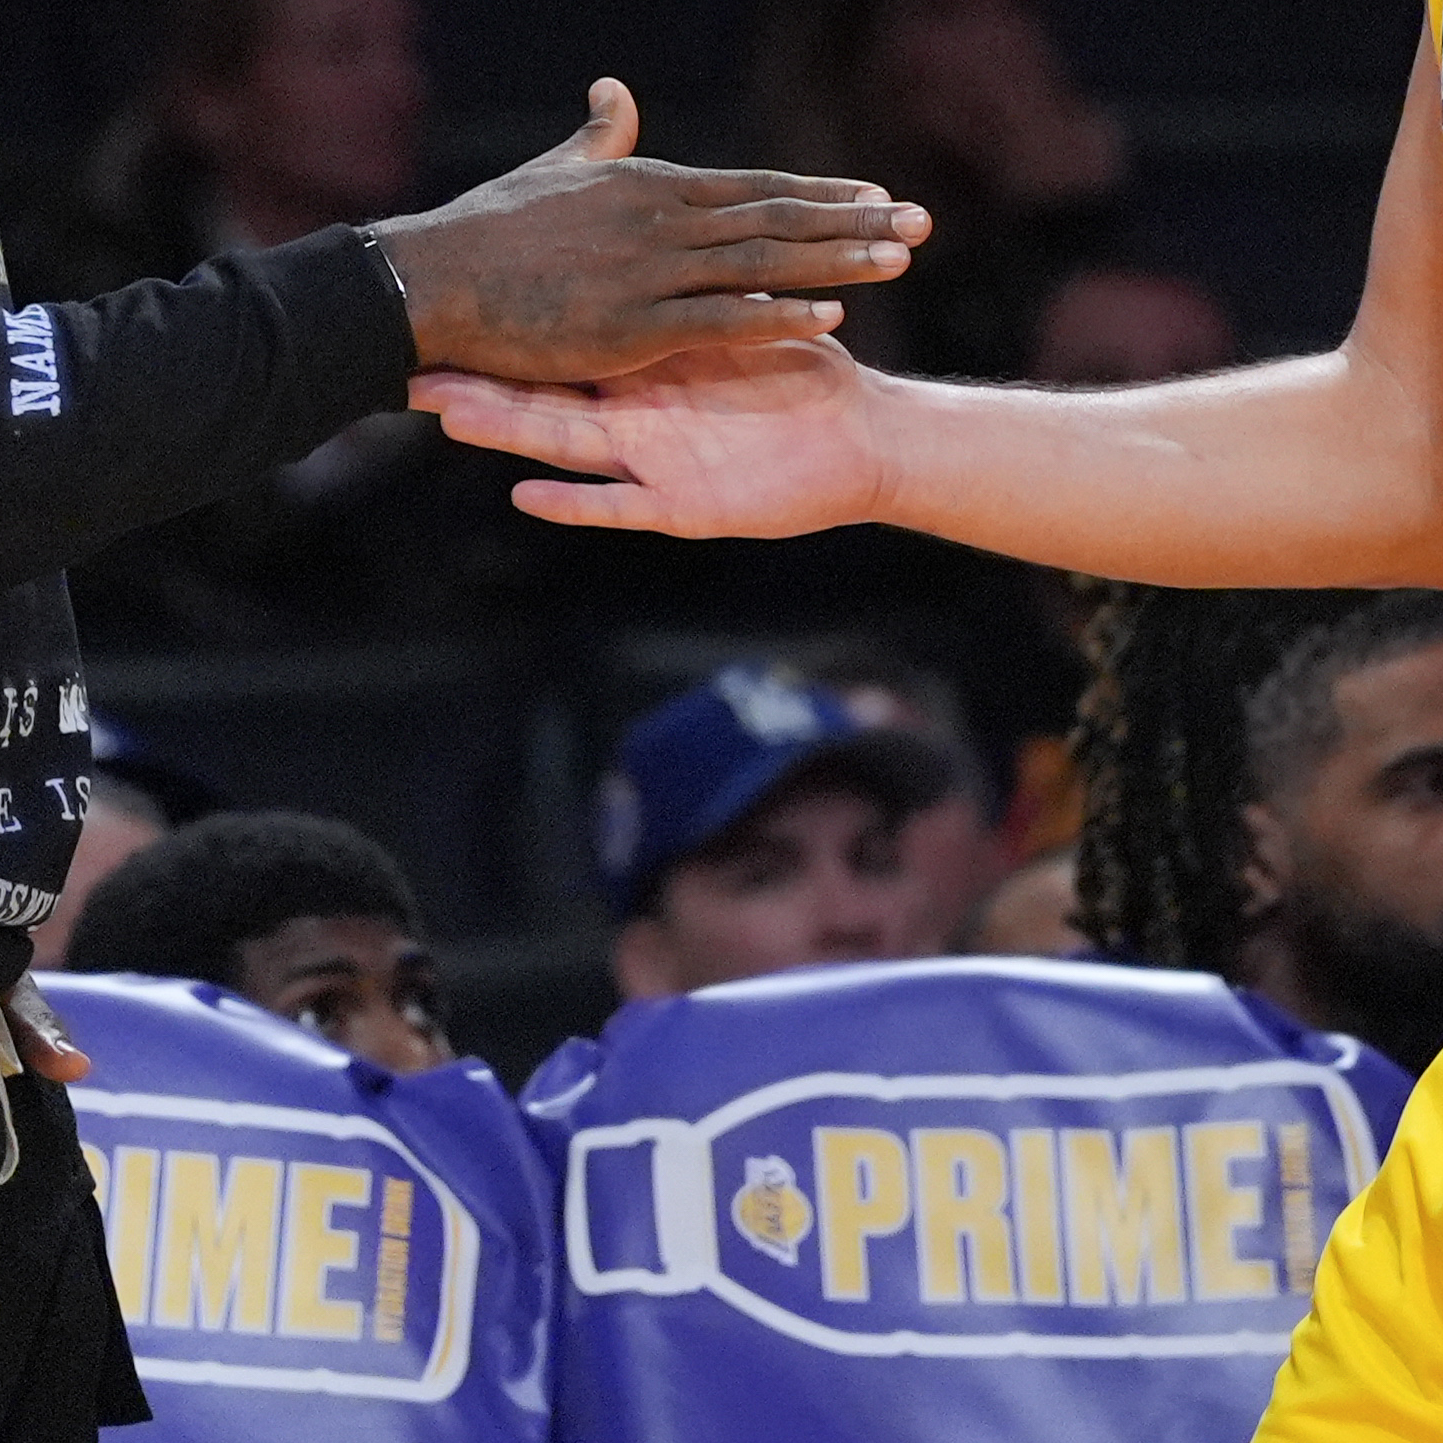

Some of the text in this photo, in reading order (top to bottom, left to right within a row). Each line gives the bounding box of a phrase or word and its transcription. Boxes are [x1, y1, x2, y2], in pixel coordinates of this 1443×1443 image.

[45, 775, 91, 822] IS
[82, 1144, 373, 1340] IME
[812, 1119, 1280, 1308] PRIME
